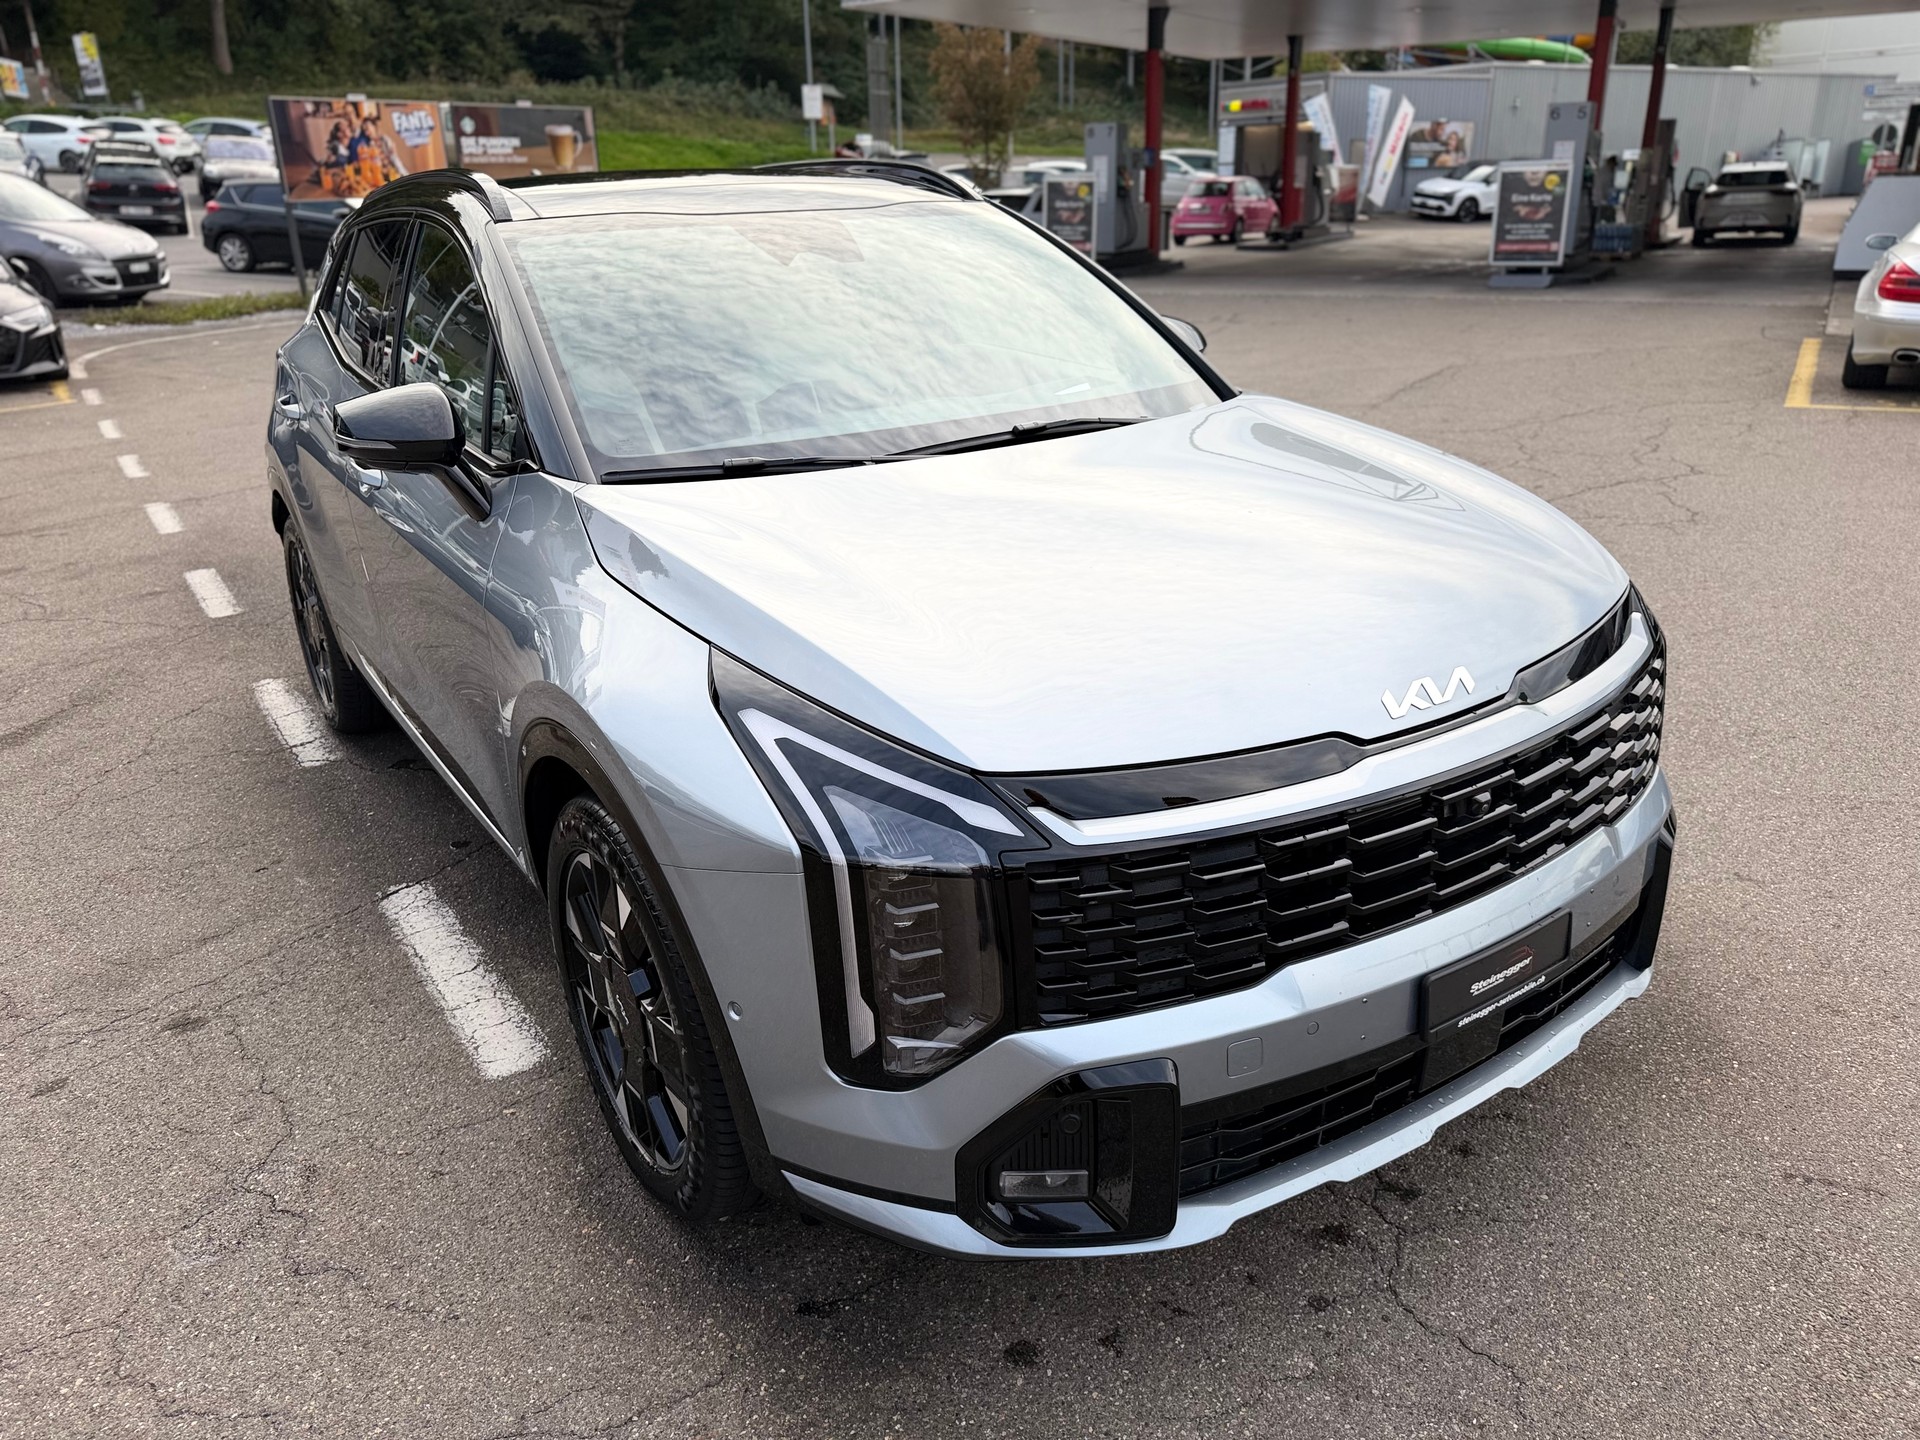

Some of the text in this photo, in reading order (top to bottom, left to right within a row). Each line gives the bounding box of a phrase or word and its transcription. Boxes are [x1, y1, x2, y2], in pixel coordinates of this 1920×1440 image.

[391, 110, 435, 132] FANTA
[1550, 105, 1587, 120] 6 5
[1381, 665, 1476, 720] KIA
[1470, 956, 1533, 993] Steinegger
